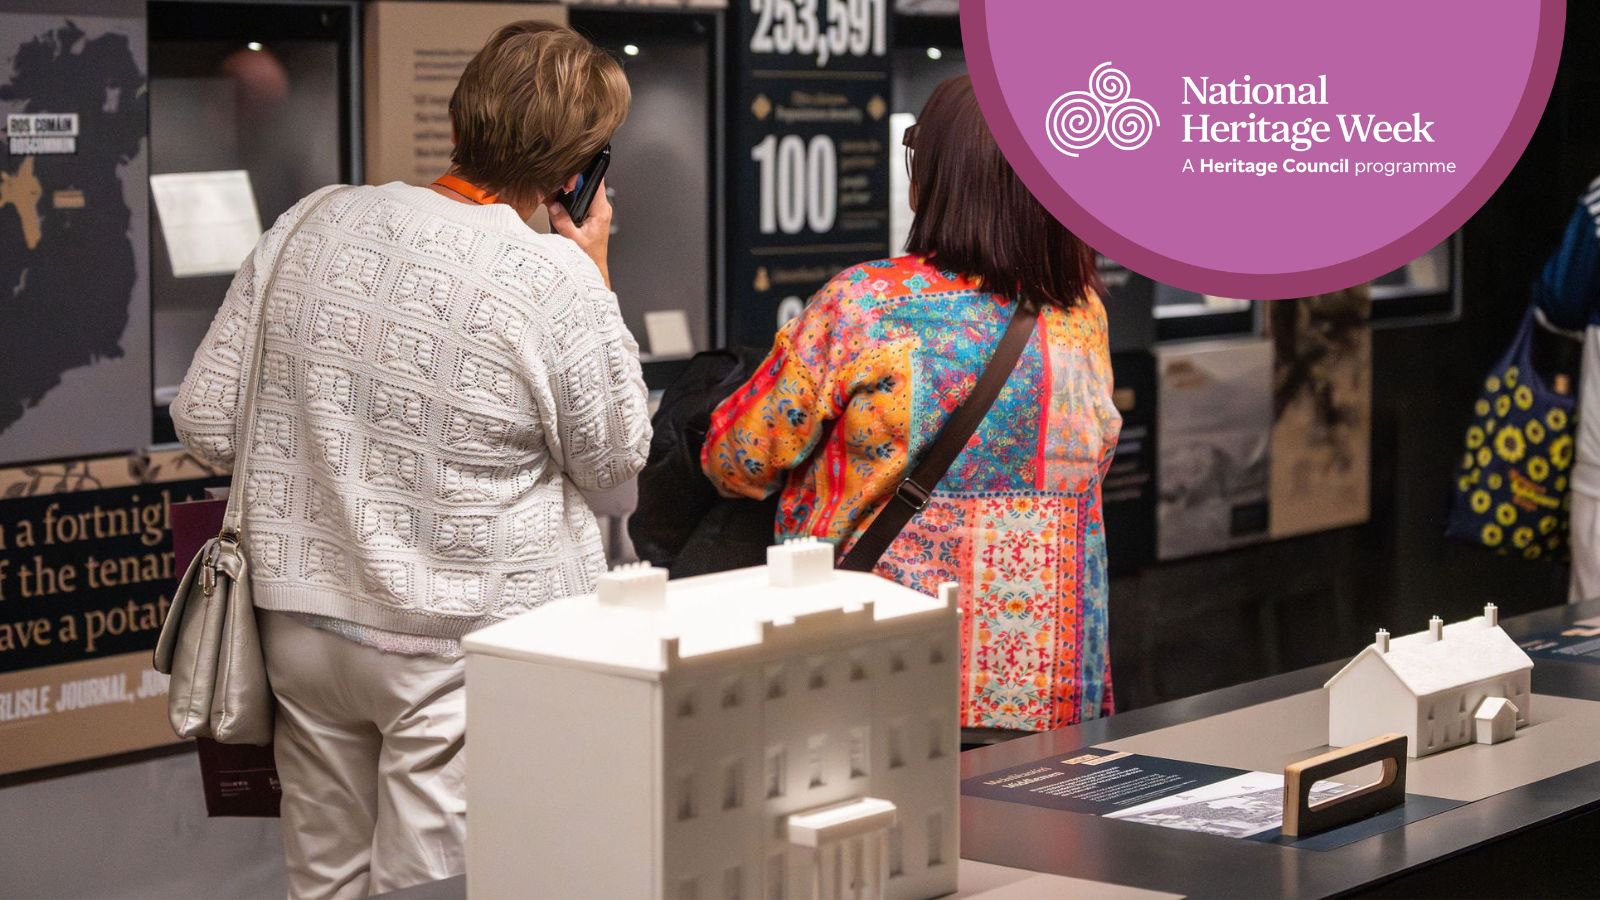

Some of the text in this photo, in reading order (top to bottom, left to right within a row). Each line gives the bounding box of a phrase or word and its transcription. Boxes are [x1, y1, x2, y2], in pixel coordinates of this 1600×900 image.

[750, 0, 887, 67] 253,591
[751, 133, 838, 234] 100
[15, 518, 36, 548] a
[43, 488, 192, 546] fortnig
[18, 554, 78, 598] the
[58, 613, 78, 643] a
